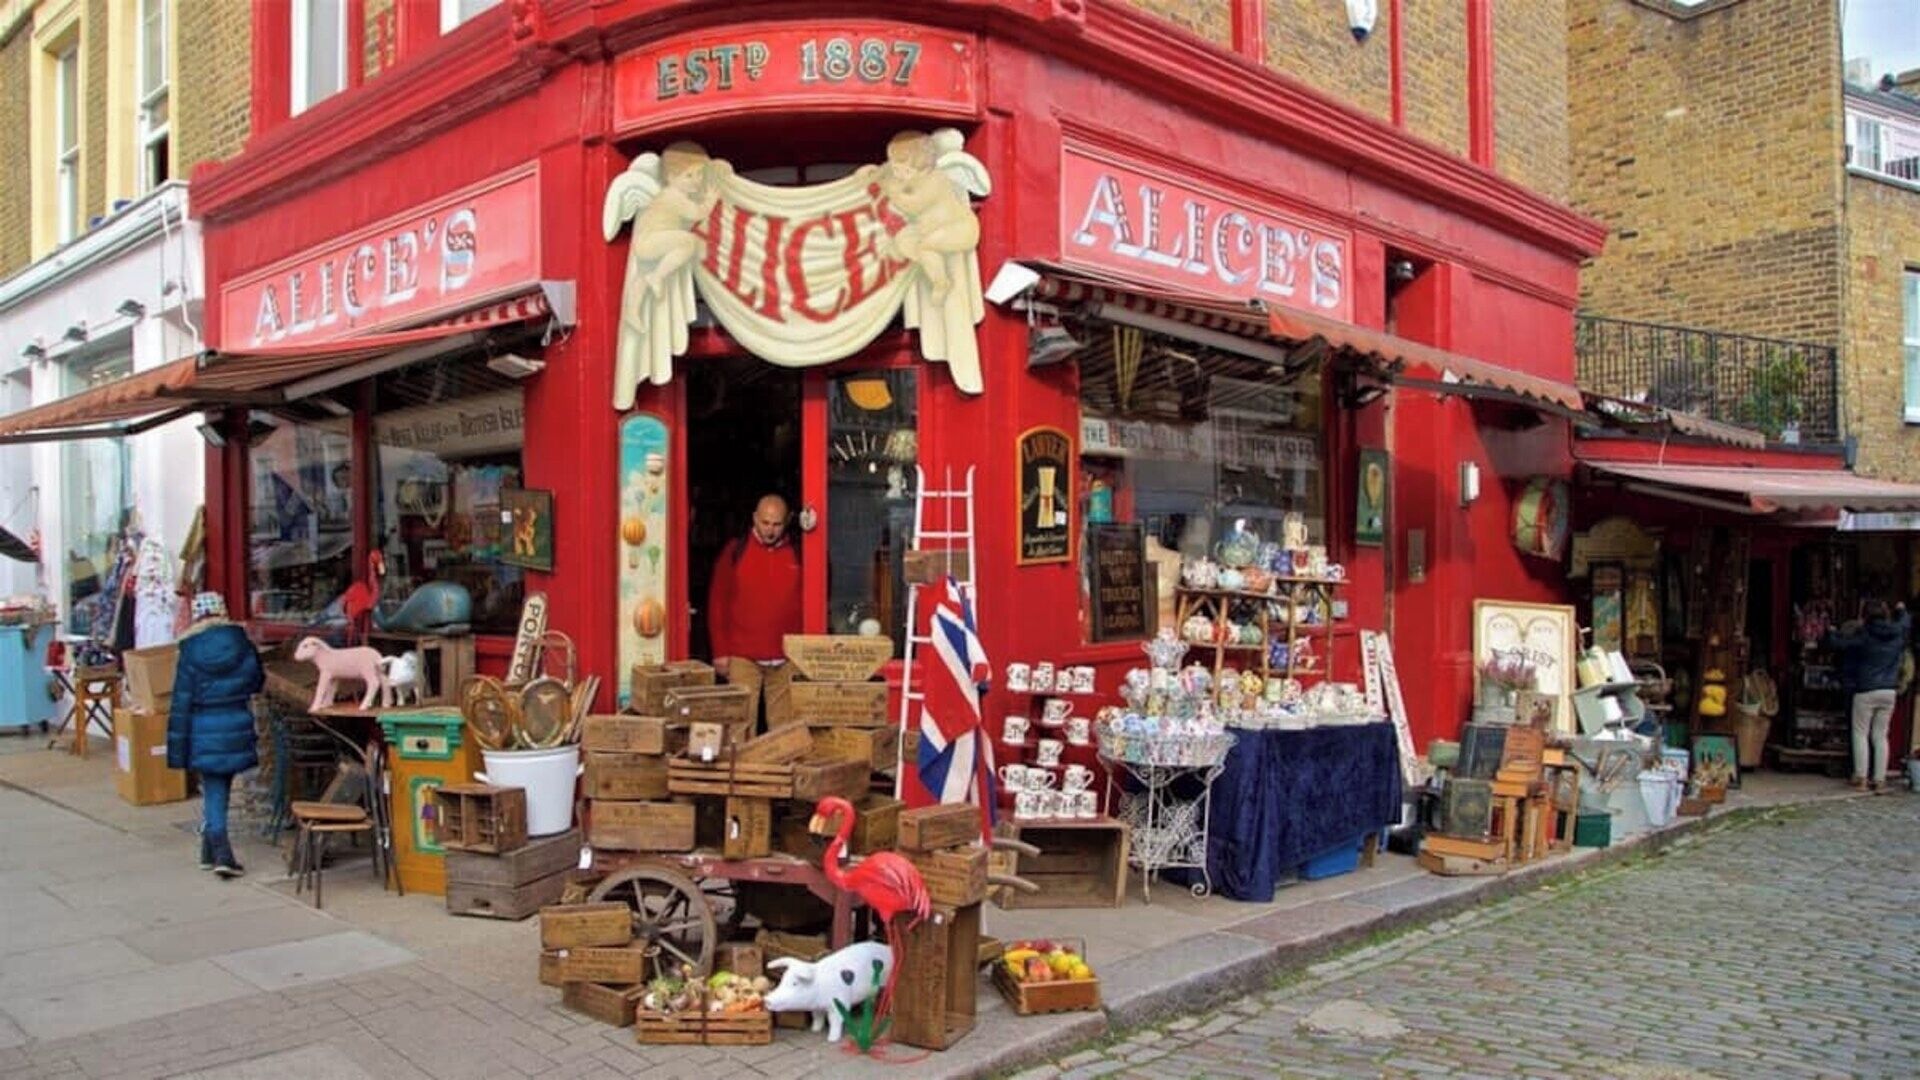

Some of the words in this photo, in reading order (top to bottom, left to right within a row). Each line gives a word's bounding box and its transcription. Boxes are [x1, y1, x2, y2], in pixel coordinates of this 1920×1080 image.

[801, 37, 921, 86] 1887
[250, 208, 478, 348] ALICE'S
[1072, 174, 1343, 309] ALICE'S
[1085, 422, 1106, 444] THE
